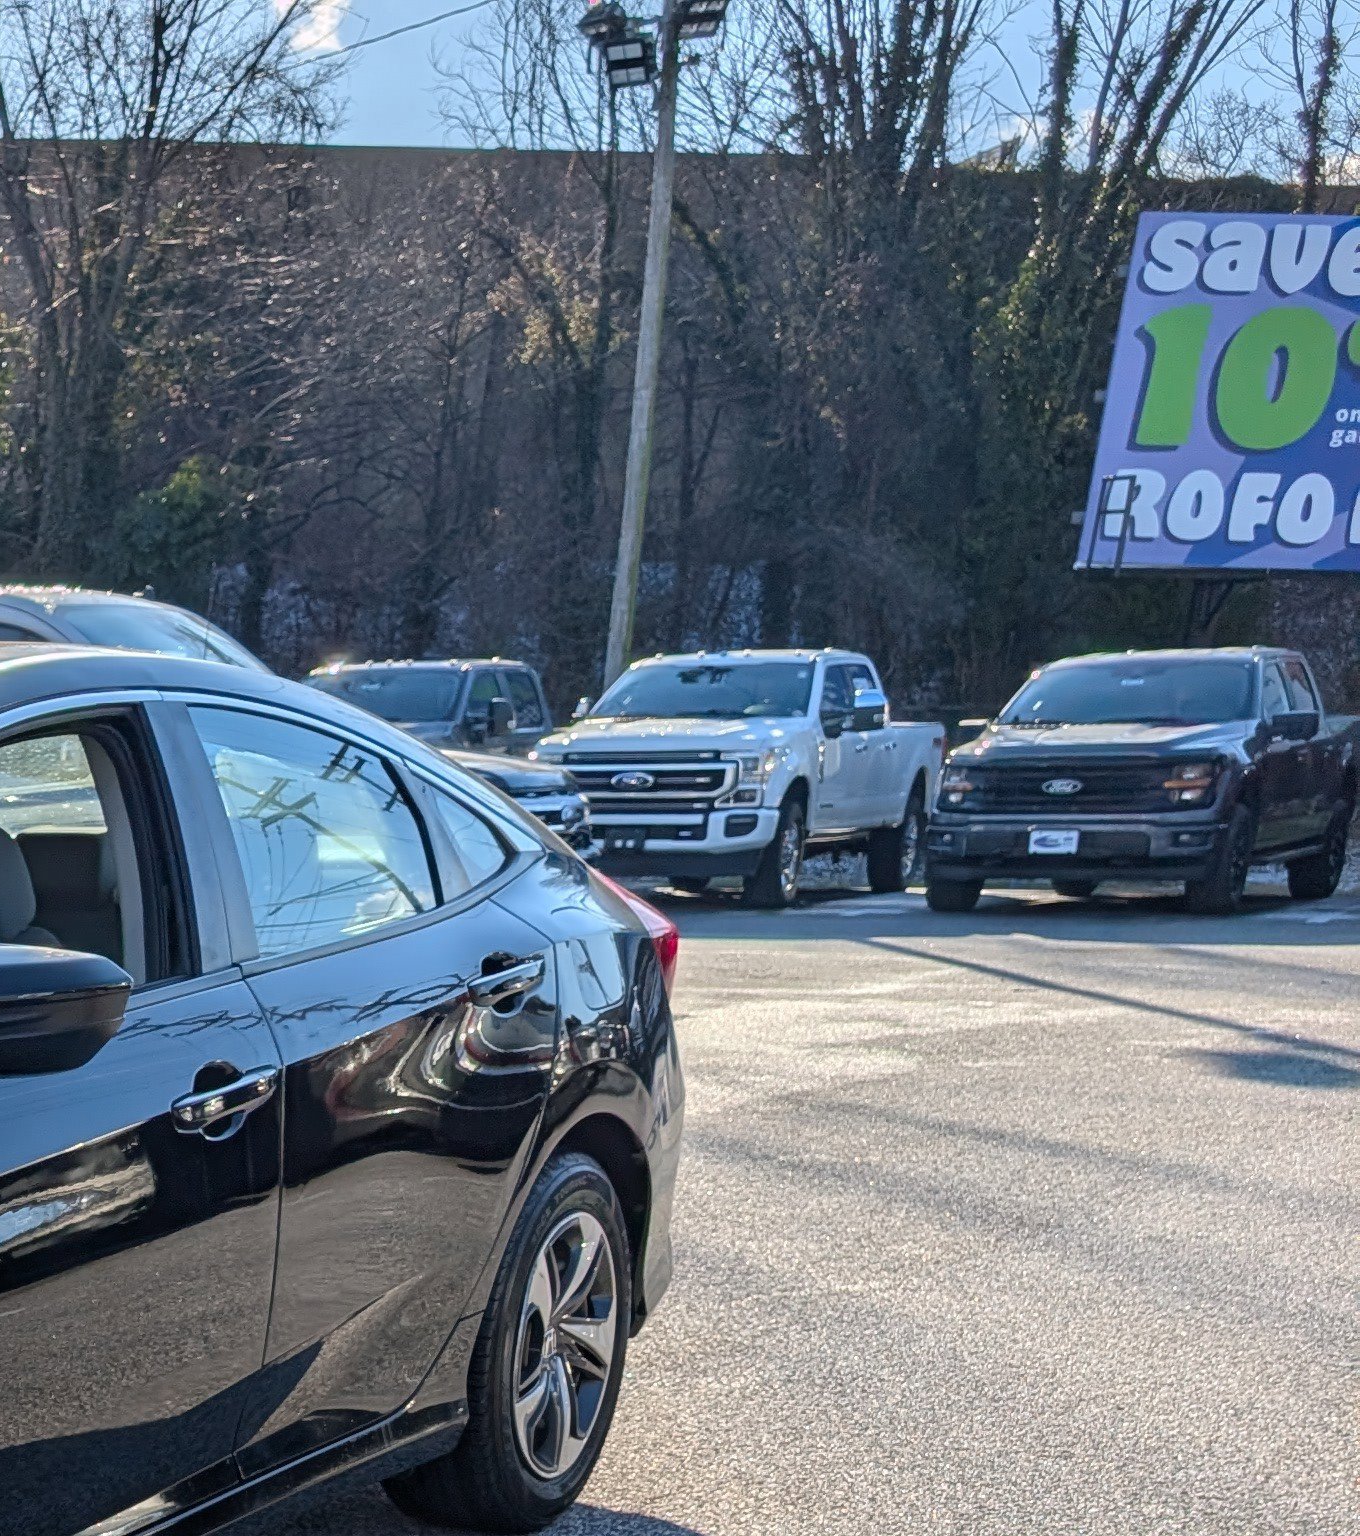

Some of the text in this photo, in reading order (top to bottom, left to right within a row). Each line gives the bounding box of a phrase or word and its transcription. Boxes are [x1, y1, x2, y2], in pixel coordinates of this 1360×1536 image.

[1134, 303, 1360, 451] 10
[1329, 429, 1360, 448] ga
[1102, 468, 1336, 545] ROFO
